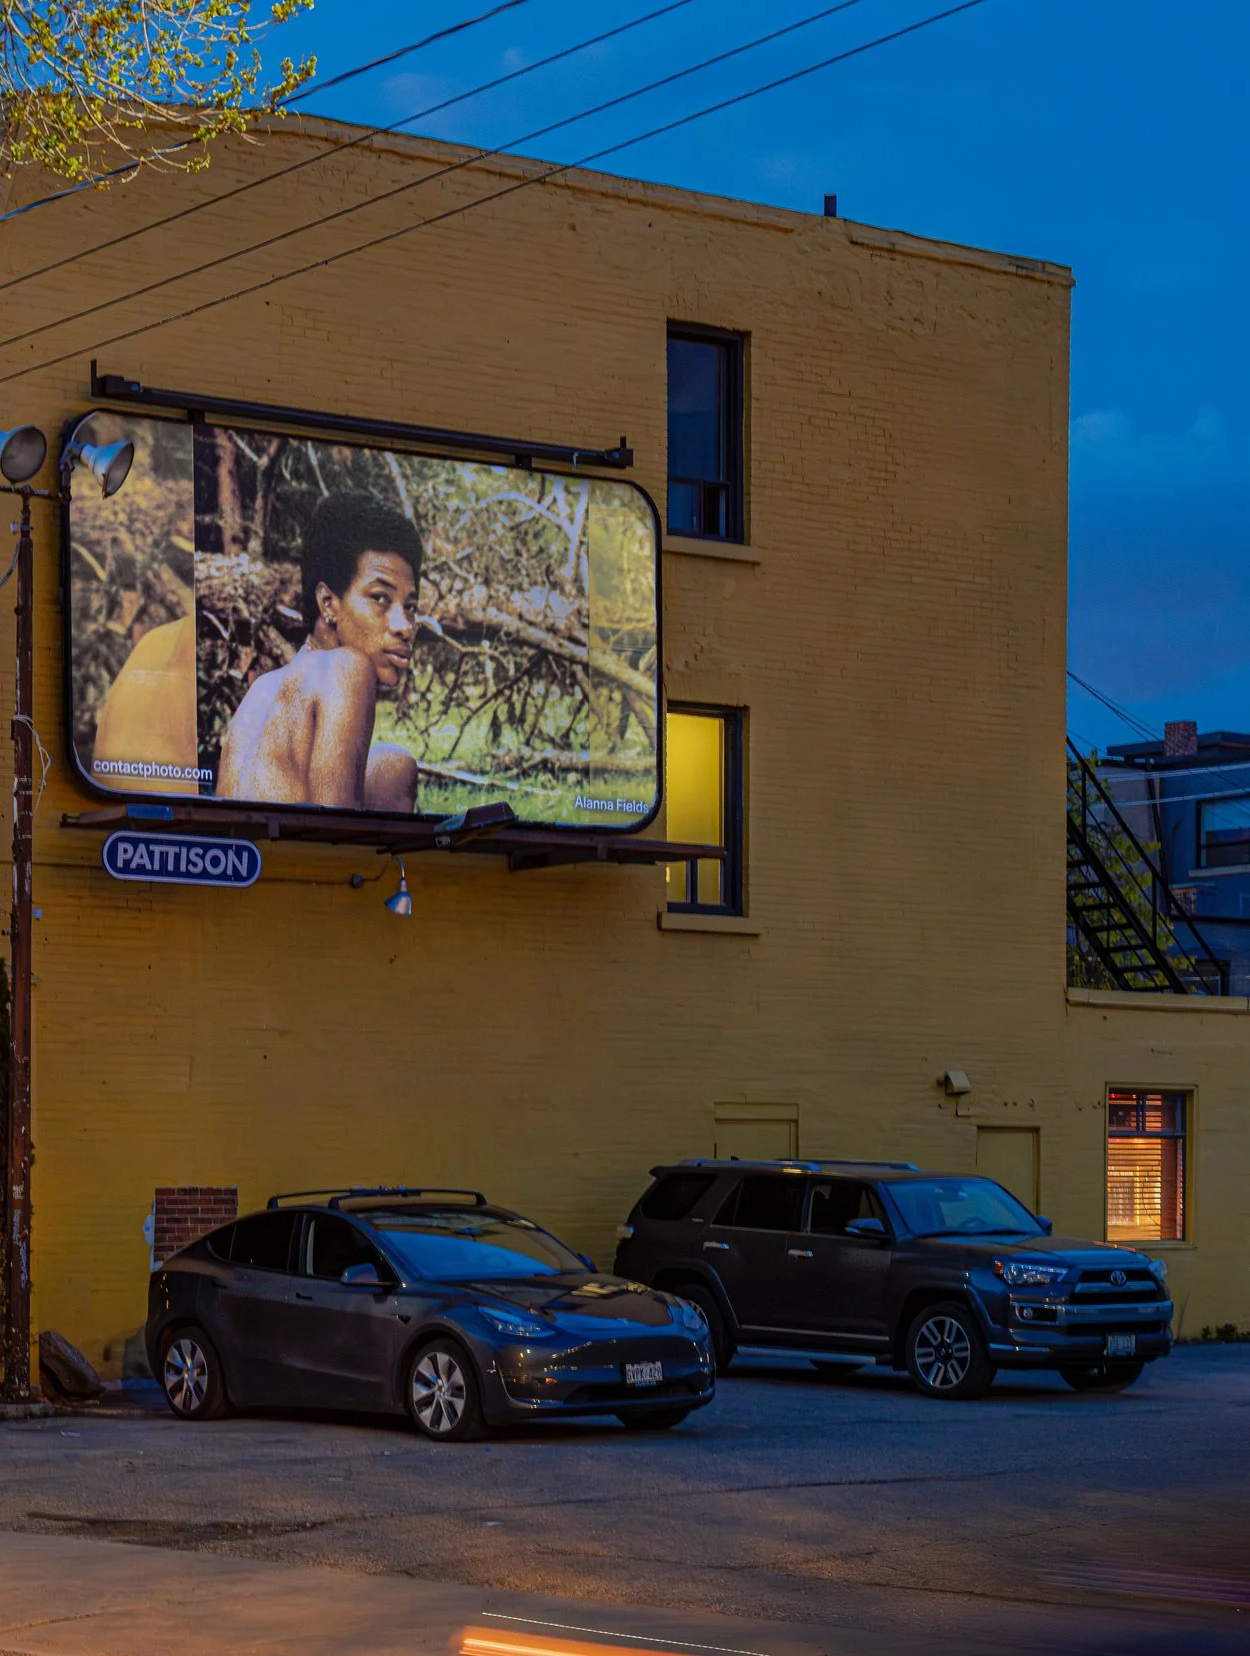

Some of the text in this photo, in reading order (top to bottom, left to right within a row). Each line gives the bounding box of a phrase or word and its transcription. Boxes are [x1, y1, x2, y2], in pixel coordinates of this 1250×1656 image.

[93, 759, 213, 781] contactphoto.com
[574, 795, 649, 814] Alanna Fields
[116, 841, 249, 878] PATTISON
